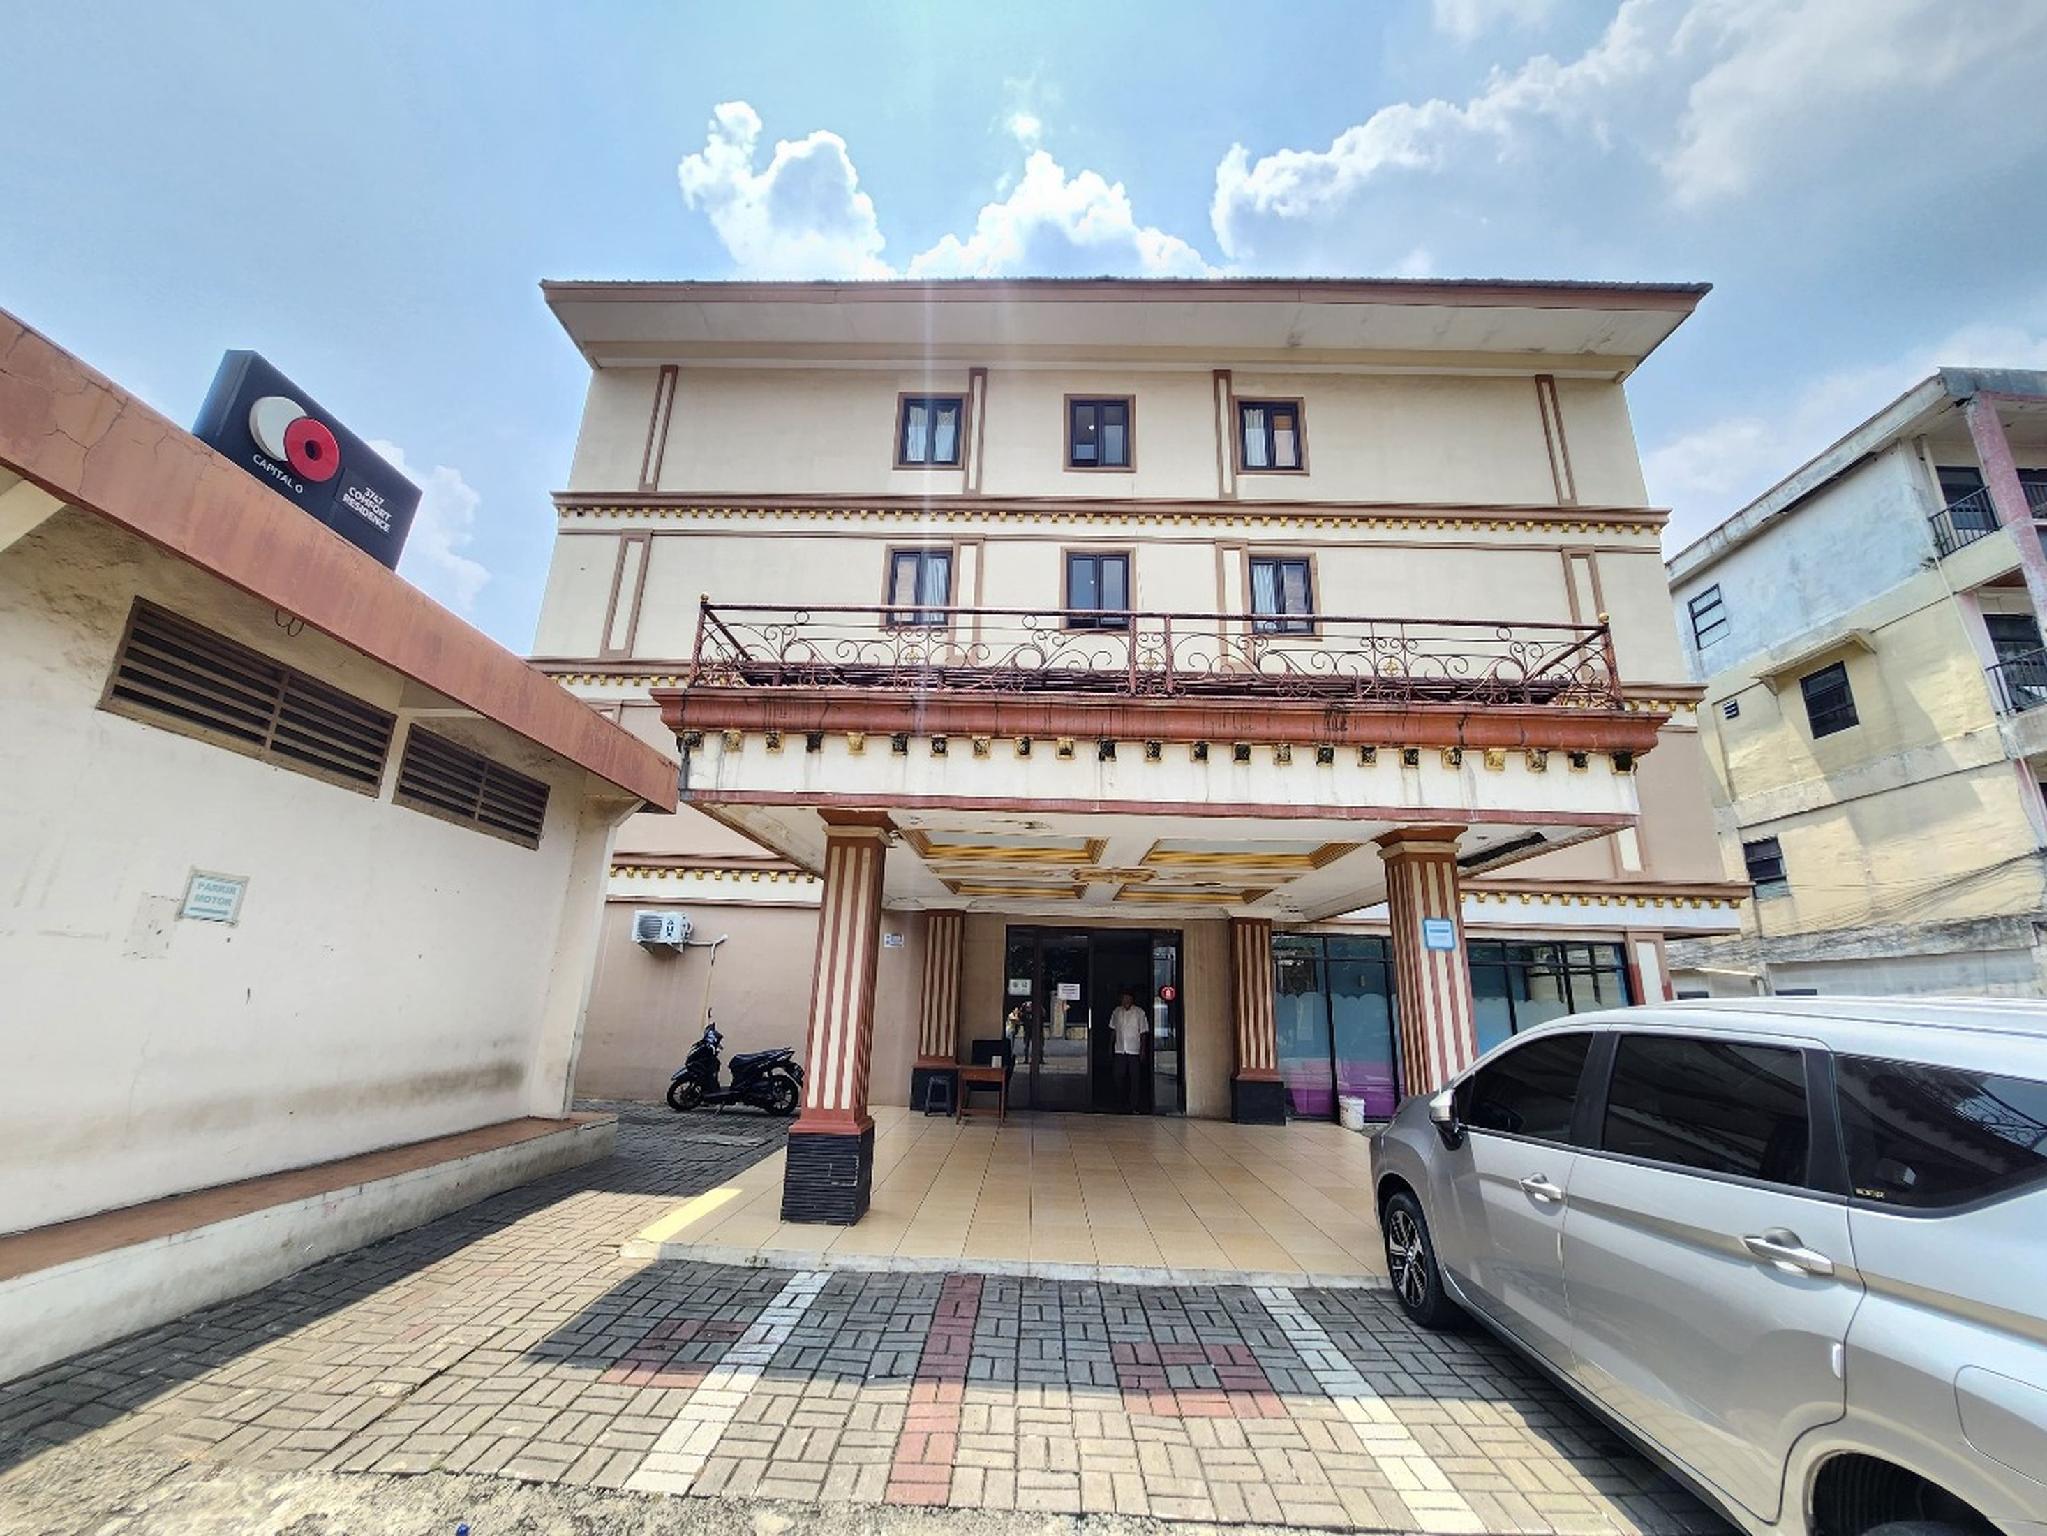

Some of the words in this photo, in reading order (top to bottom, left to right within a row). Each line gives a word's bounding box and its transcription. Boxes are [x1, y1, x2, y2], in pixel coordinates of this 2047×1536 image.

[253, 454, 293, 488] CAPITAL
[295, 484, 303, 494] O
[342, 493, 391, 533] RESIDENCE
[349, 487, 392, 521] COMFORT
[194, 894, 233, 906] MOTOR
[197, 881, 237, 895] PARKIR
